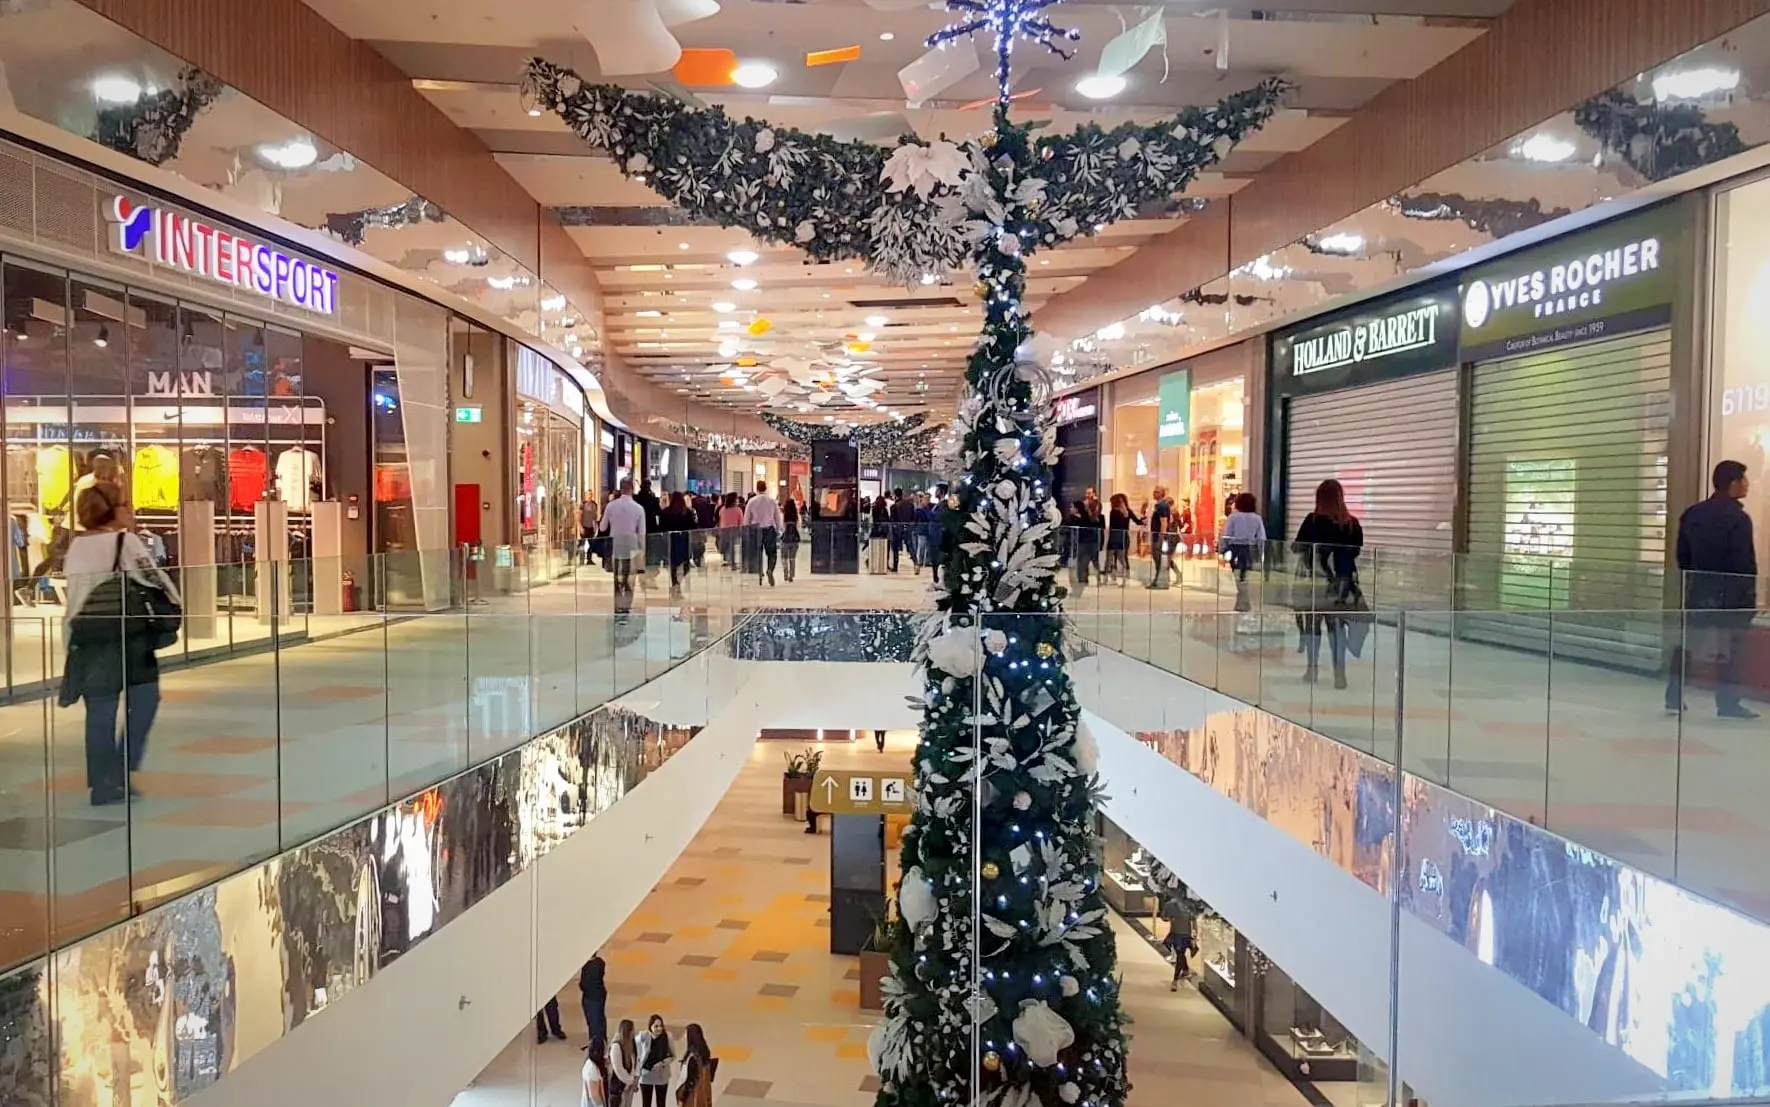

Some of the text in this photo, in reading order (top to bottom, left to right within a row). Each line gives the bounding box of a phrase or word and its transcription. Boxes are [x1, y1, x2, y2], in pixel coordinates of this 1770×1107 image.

[155, 208, 339, 315] INTERSPORT
[1491, 238, 1660, 310] YVES ROCHER
[1535, 289, 1601, 318] FRANCE
[1589, 321, 1604, 334] 1959
[1293, 304, 1439, 376] HOLLAND & BARRETT
[148, 371, 212, 394] MAN
